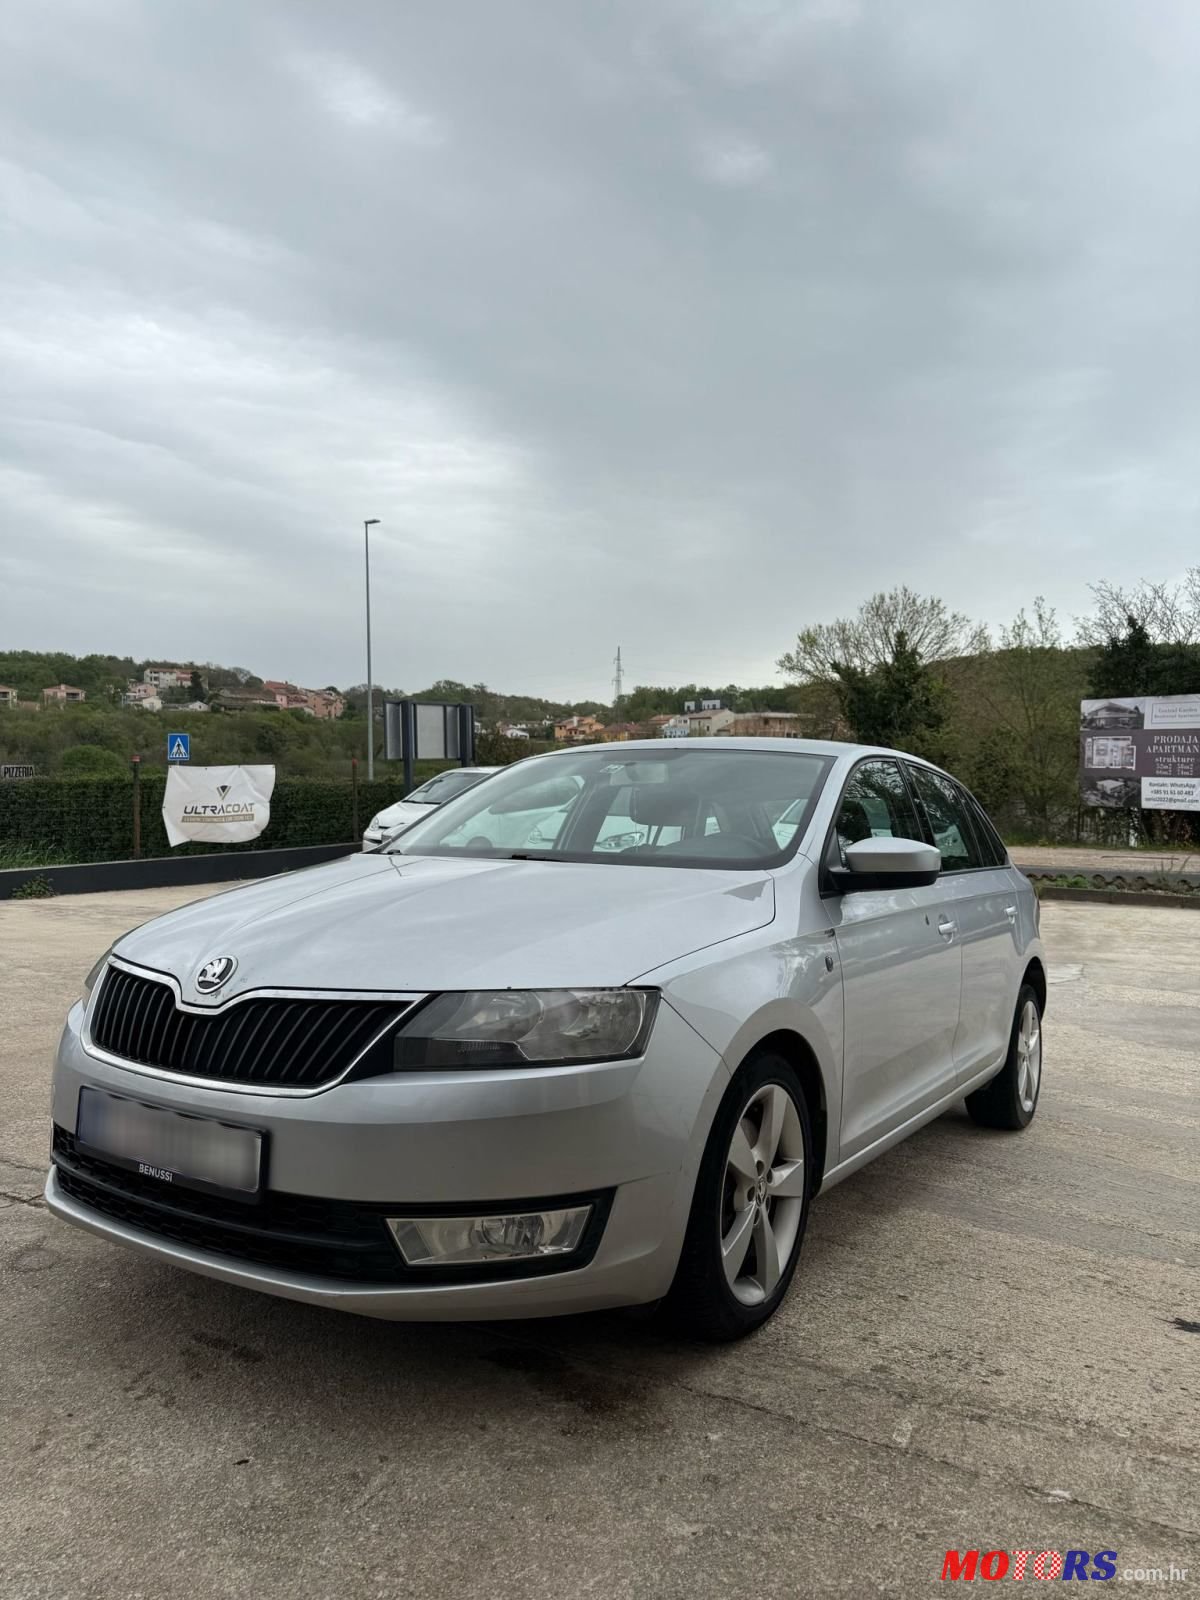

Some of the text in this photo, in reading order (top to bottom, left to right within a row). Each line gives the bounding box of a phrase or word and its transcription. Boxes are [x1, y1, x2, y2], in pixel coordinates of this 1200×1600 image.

[1154, 735, 1199, 744] PRODAJA
[1155, 754, 1196, 763] strukture
[3, 766, 34, 777] PIZZERIA
[184, 803, 255, 815] ULTRACOAT
[139, 1163, 173, 1182] BENUSSI
